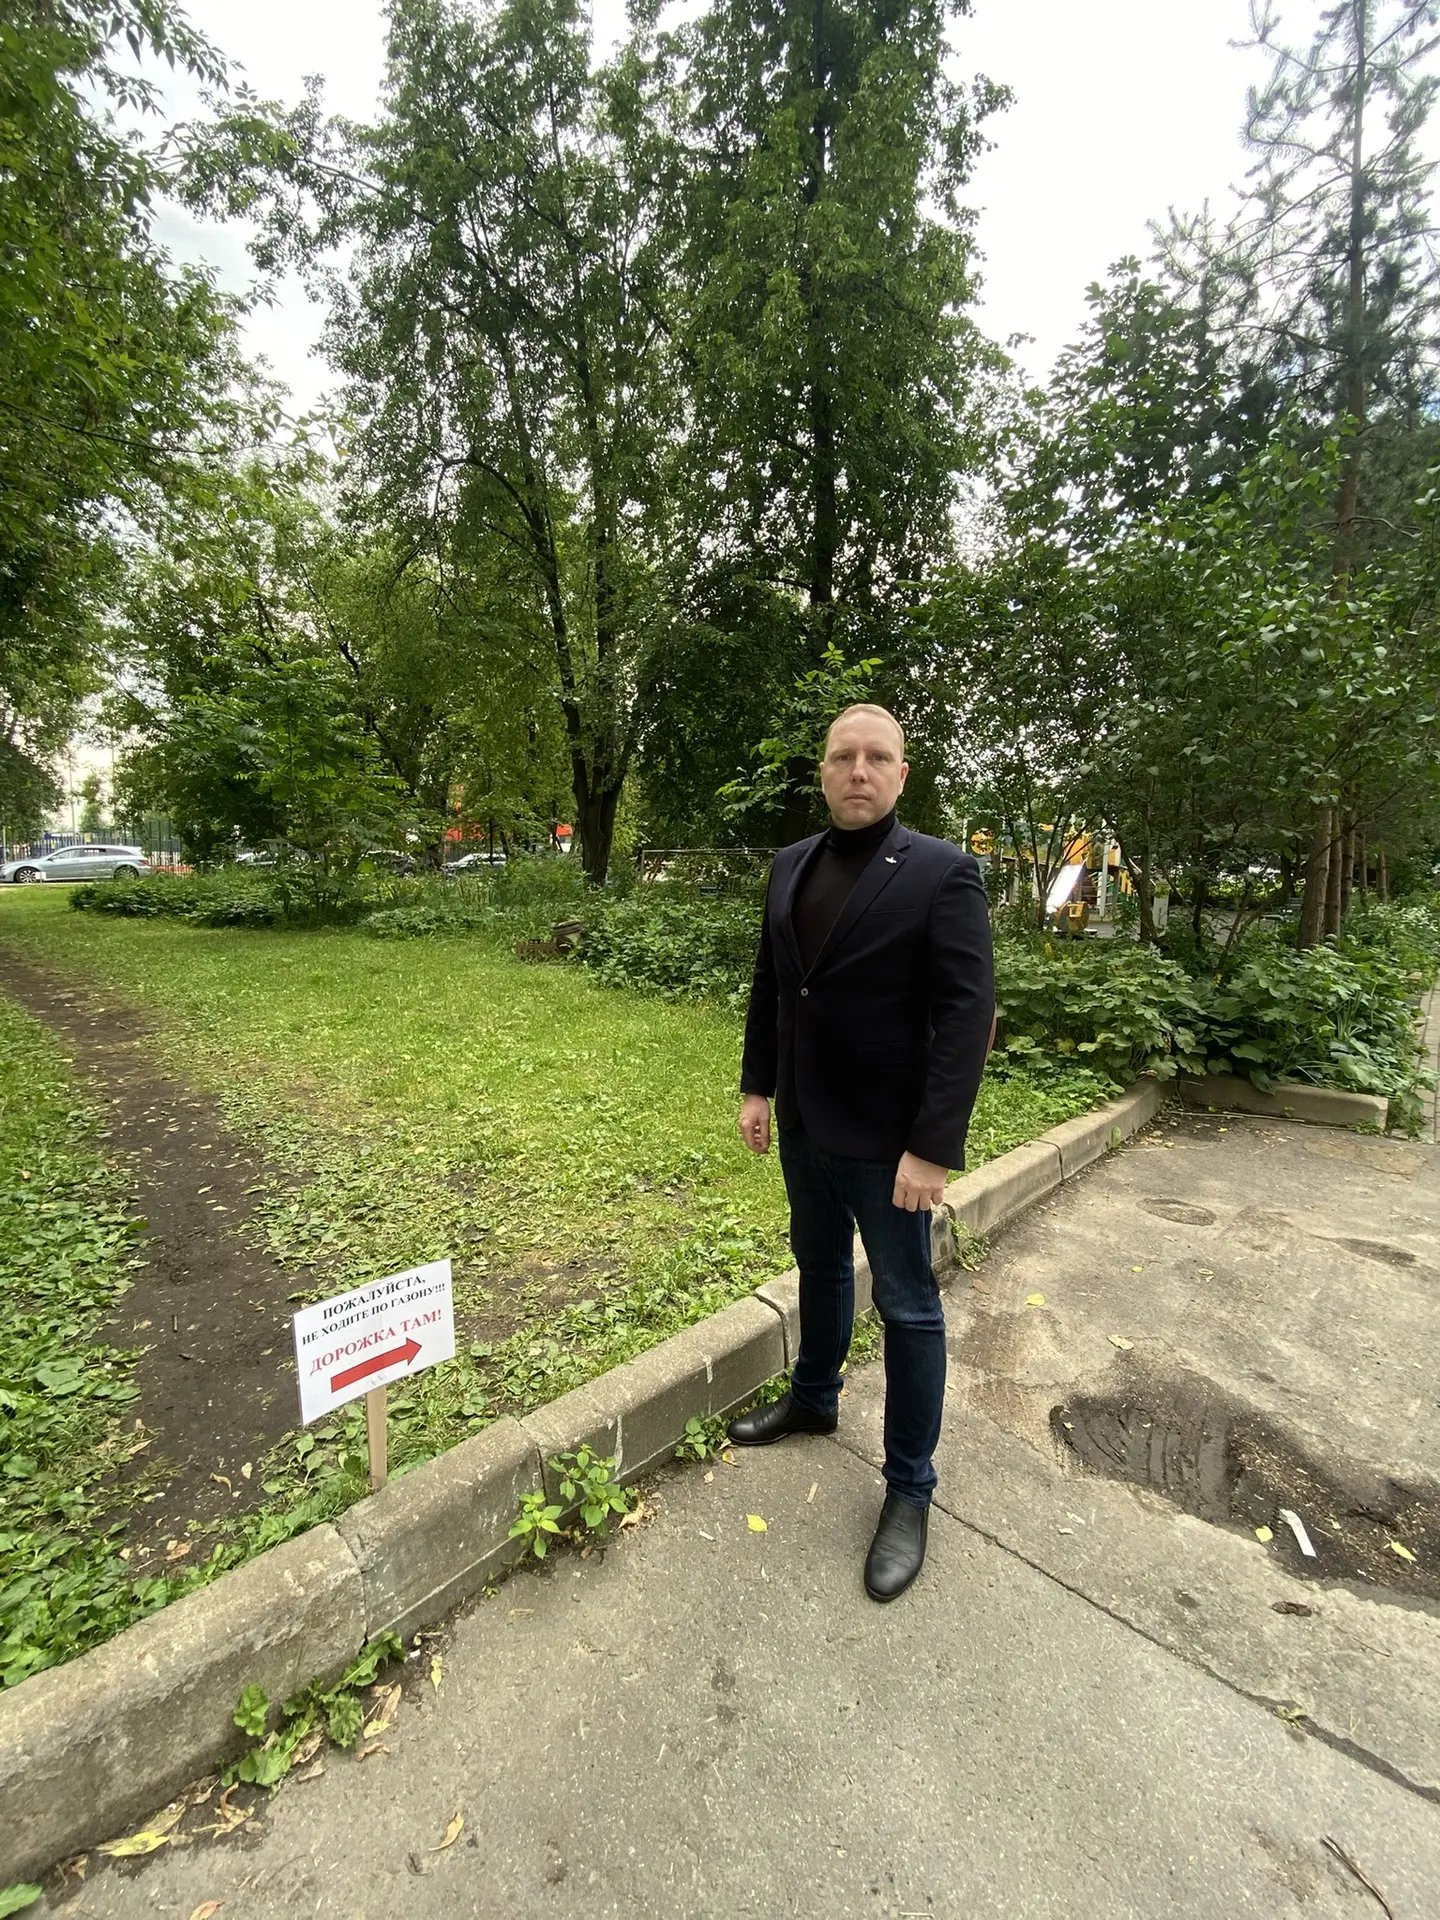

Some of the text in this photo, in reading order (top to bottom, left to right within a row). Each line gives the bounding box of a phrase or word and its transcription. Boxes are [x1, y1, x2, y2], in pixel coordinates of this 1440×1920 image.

[302, 1283, 446, 1346] НЕ ХОДИТЕ ПО ГАЗОНУ!!!
[323, 1275, 426, 1320] ПОЖАЛУЙСТА,
[309, 1309, 442, 1377] ДОРОЖКА ТАМ!
